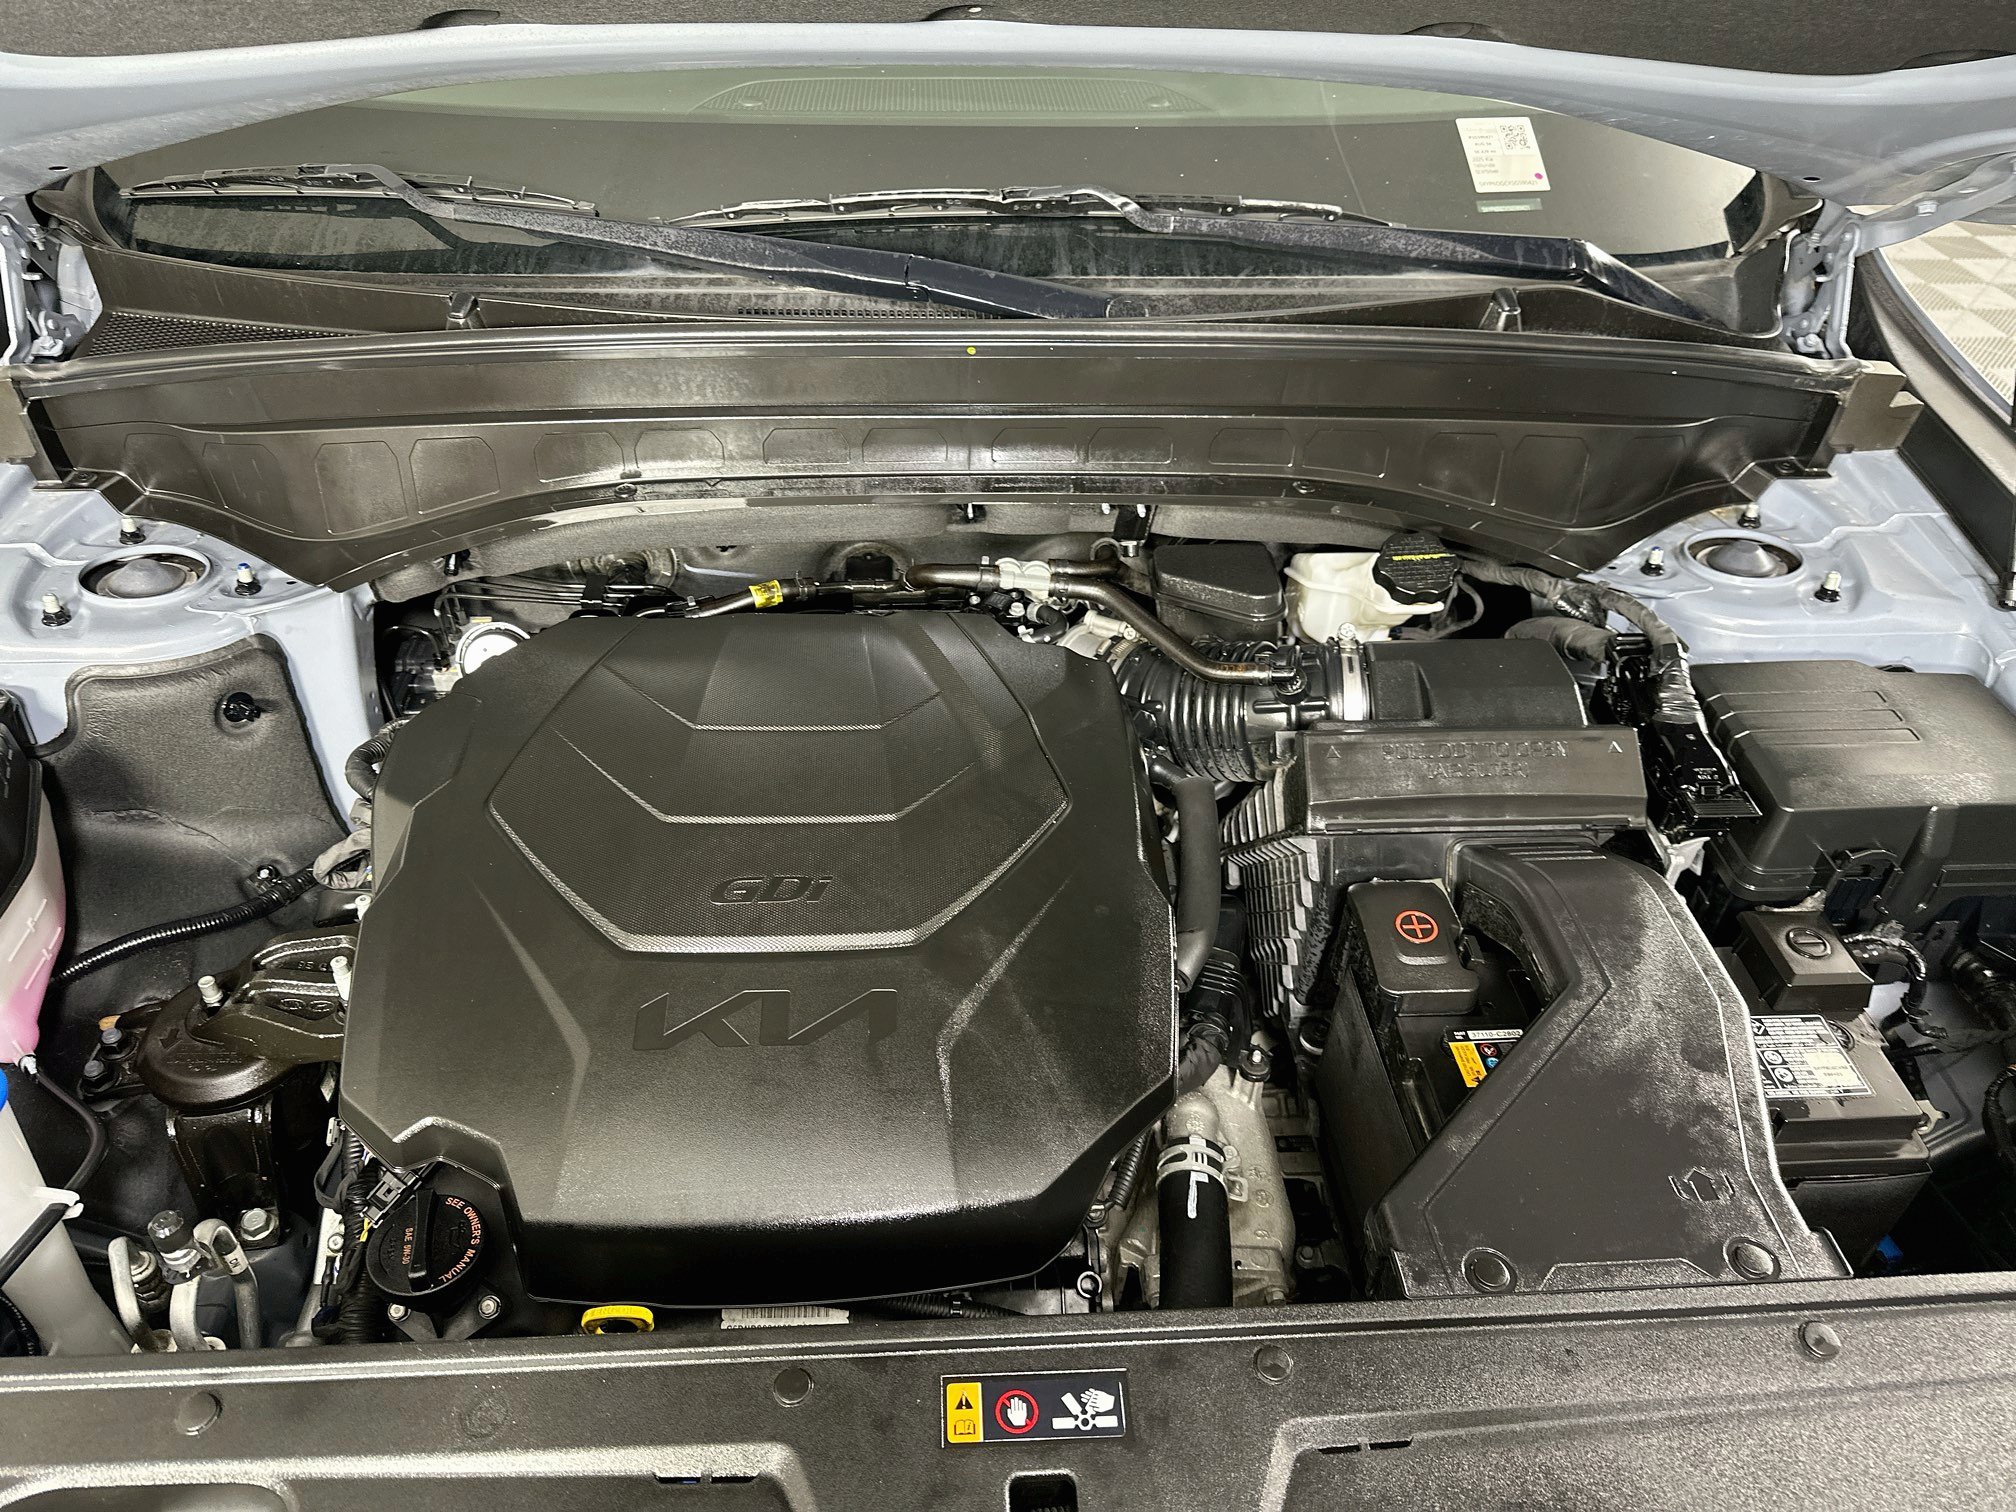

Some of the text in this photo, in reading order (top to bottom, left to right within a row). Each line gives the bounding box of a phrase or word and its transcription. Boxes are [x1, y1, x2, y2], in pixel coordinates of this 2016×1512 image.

[709, 875, 833, 905] GDi
[633, 989, 898, 1050] KIA
[438, 1197, 481, 1282] SEE OWNER'S MANUAL
